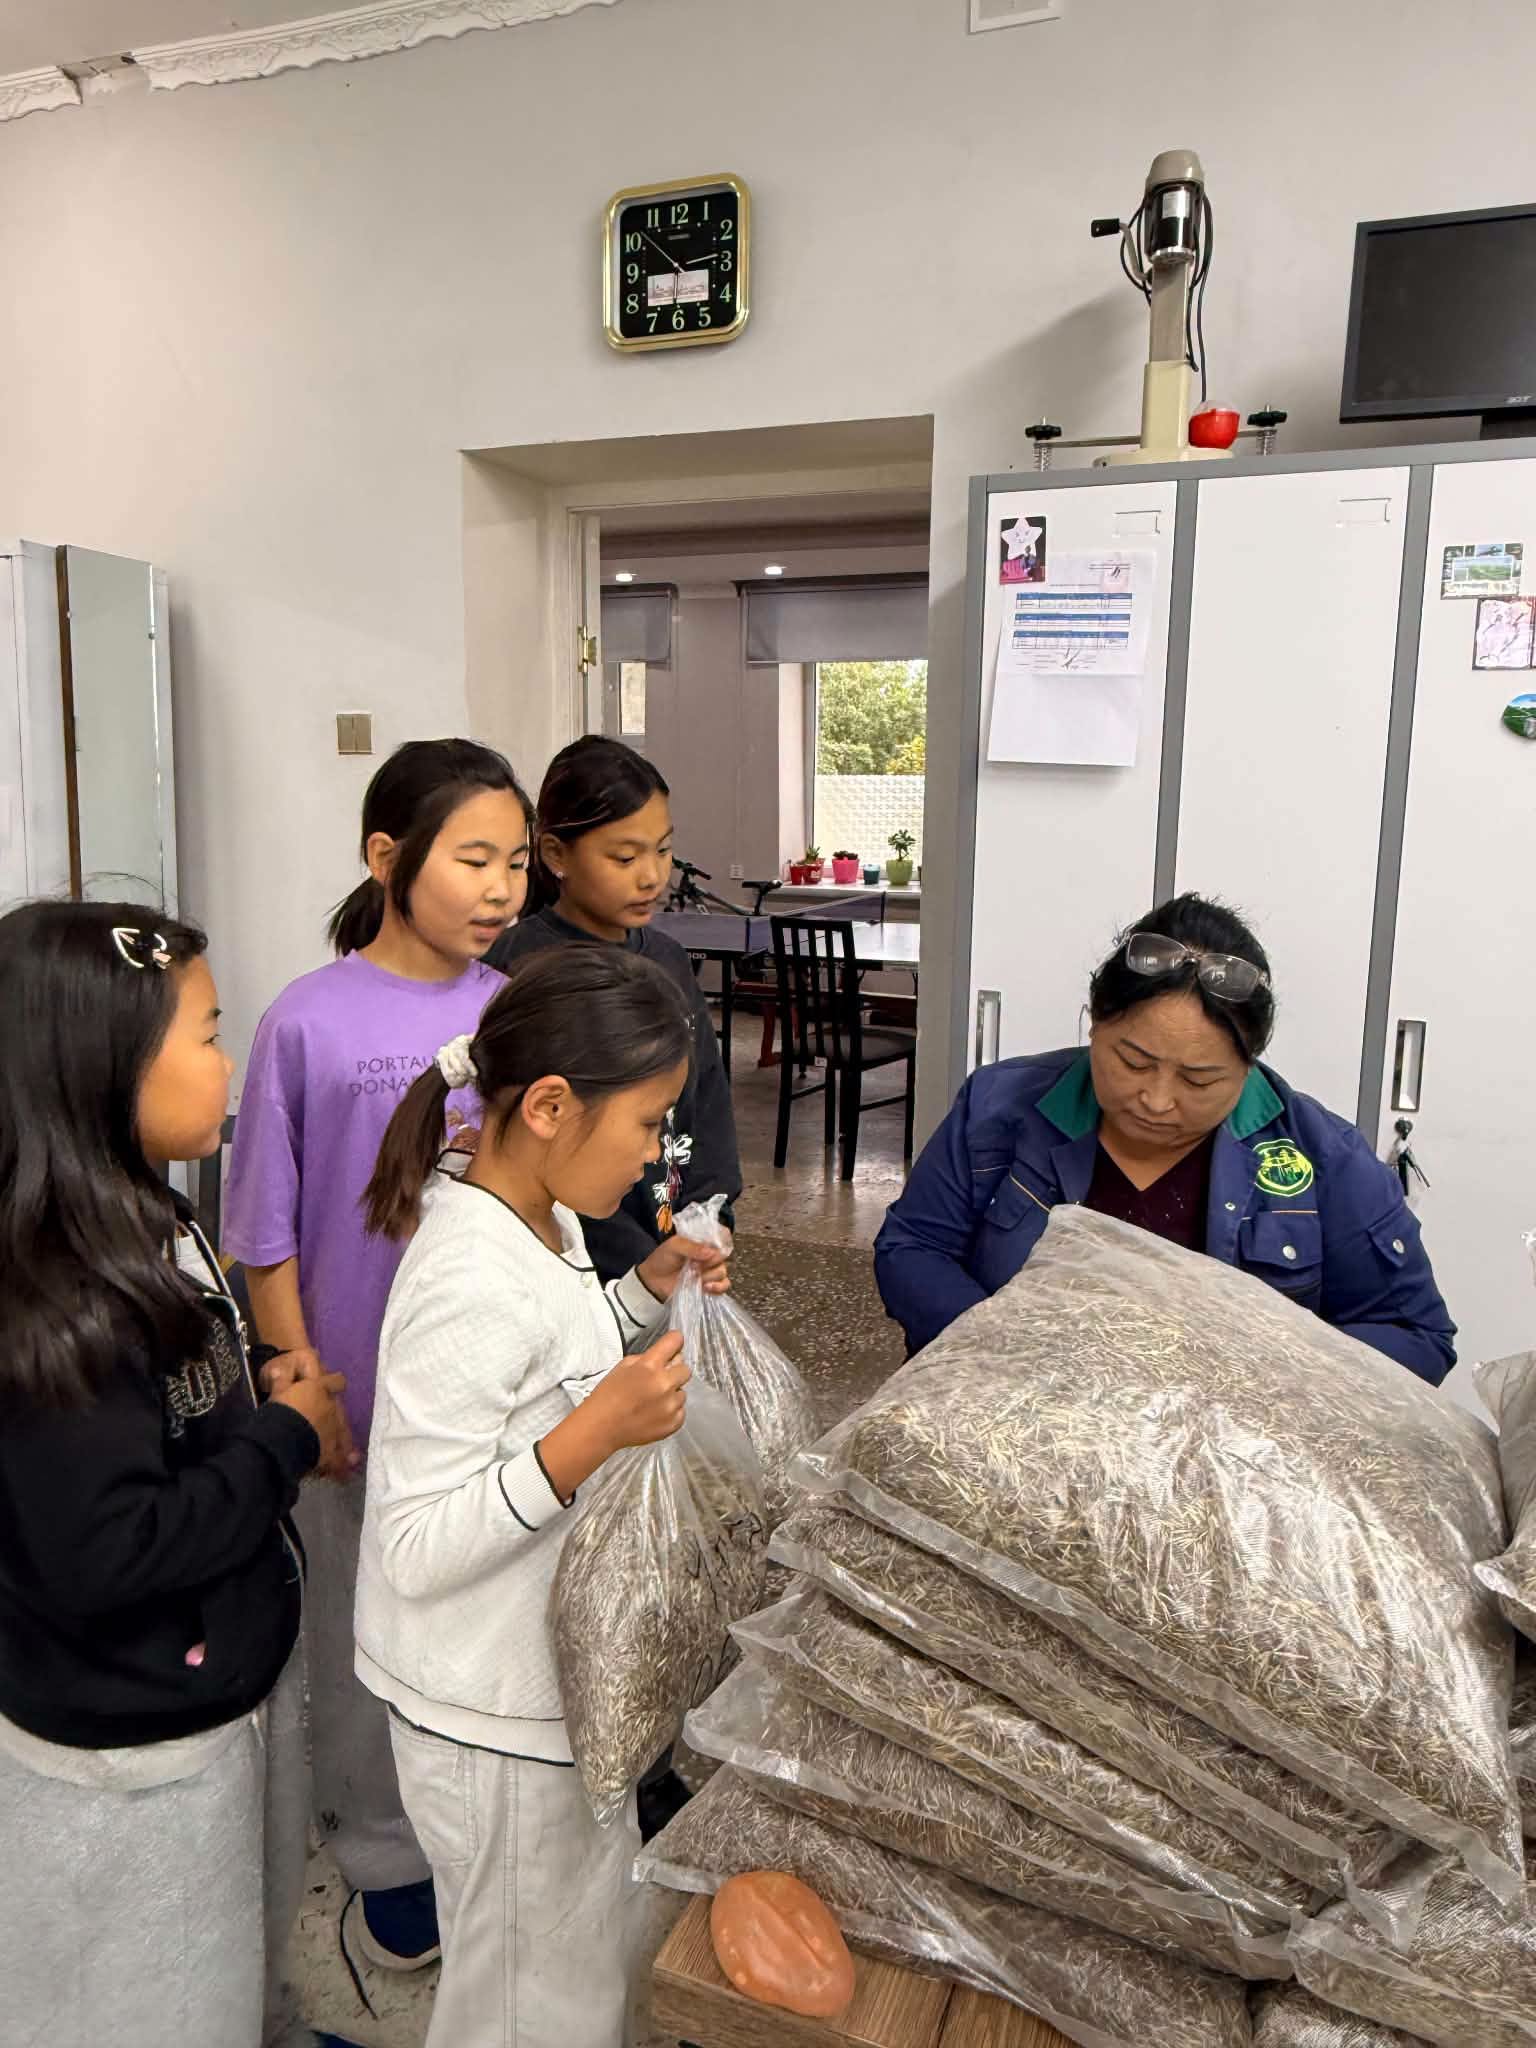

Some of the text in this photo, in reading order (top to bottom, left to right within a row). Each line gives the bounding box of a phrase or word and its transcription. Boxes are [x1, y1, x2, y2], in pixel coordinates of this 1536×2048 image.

[647, 208, 659, 228] 11
[671, 203, 689, 225] 12
[703, 201, 709, 221] 1
[720, 219, 733, 240] 2
[625, 232, 642, 253] 10
[720, 250, 732, 272] 3
[626, 263, 640, 284] 9
[720, 282, 732, 303] 4
[626, 293, 640, 314] 8
[646, 312, 658, 333] 7
[672, 309, 685, 330] 6
[698, 306, 711, 327] 5
[357, 1056, 434, 1074] PORTAL
[350, 1076, 415, 1097] DONA
